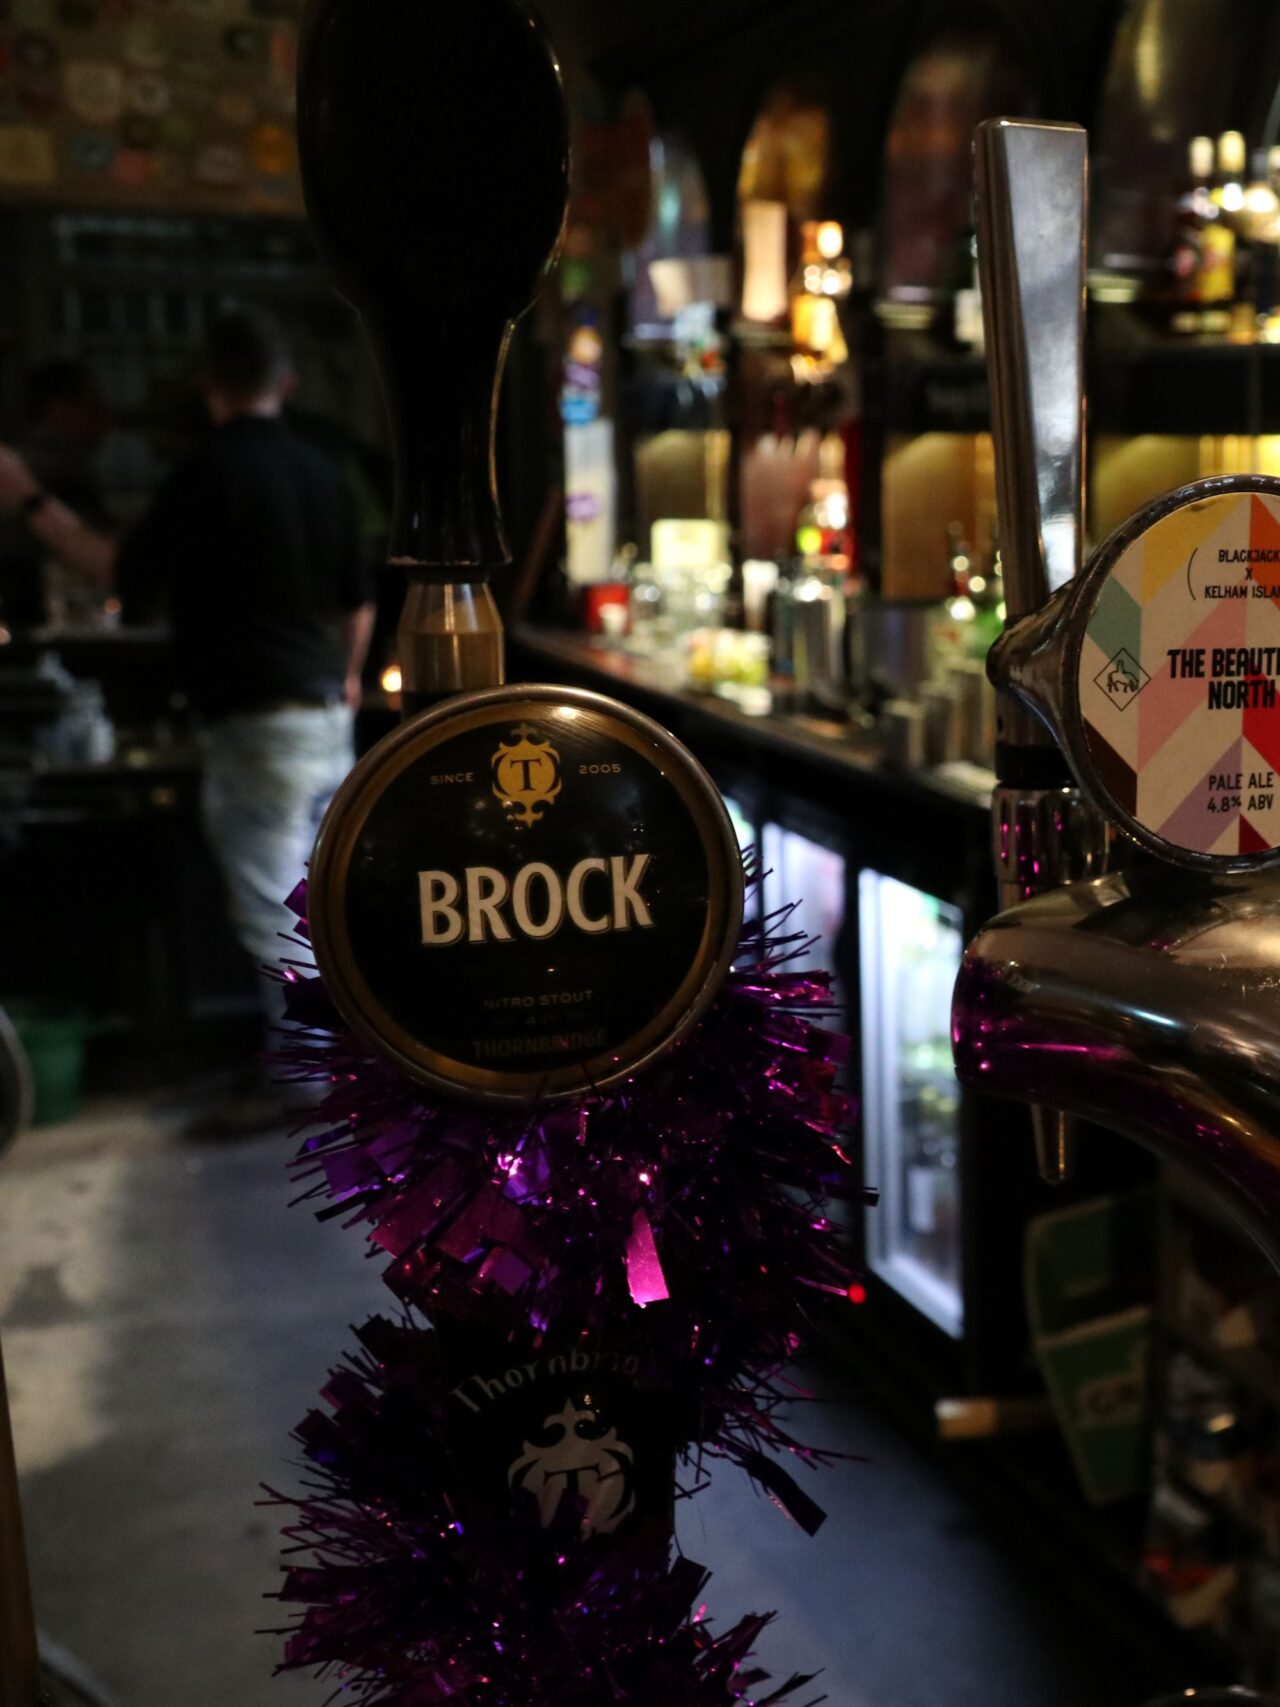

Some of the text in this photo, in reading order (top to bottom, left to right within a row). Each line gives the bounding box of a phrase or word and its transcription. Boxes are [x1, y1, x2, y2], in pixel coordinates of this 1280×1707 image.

[1218, 550, 1280, 563] BLACKJACK
[1204, 586, 1248, 599] KELHAM
[1167, 650, 1205, 680] THE
[1208, 679, 1276, 709] NORTH
[429, 763, 622, 785] SINCE 2005
[1208, 772, 1274, 791] PALE ALE
[1207, 794, 1273, 813] 4.8% ABV
[416, 853, 657, 948] BROCK
[483, 989, 593, 1009] NITRO STOUT
[471, 1029, 609, 1059] THORNBRIDGE
